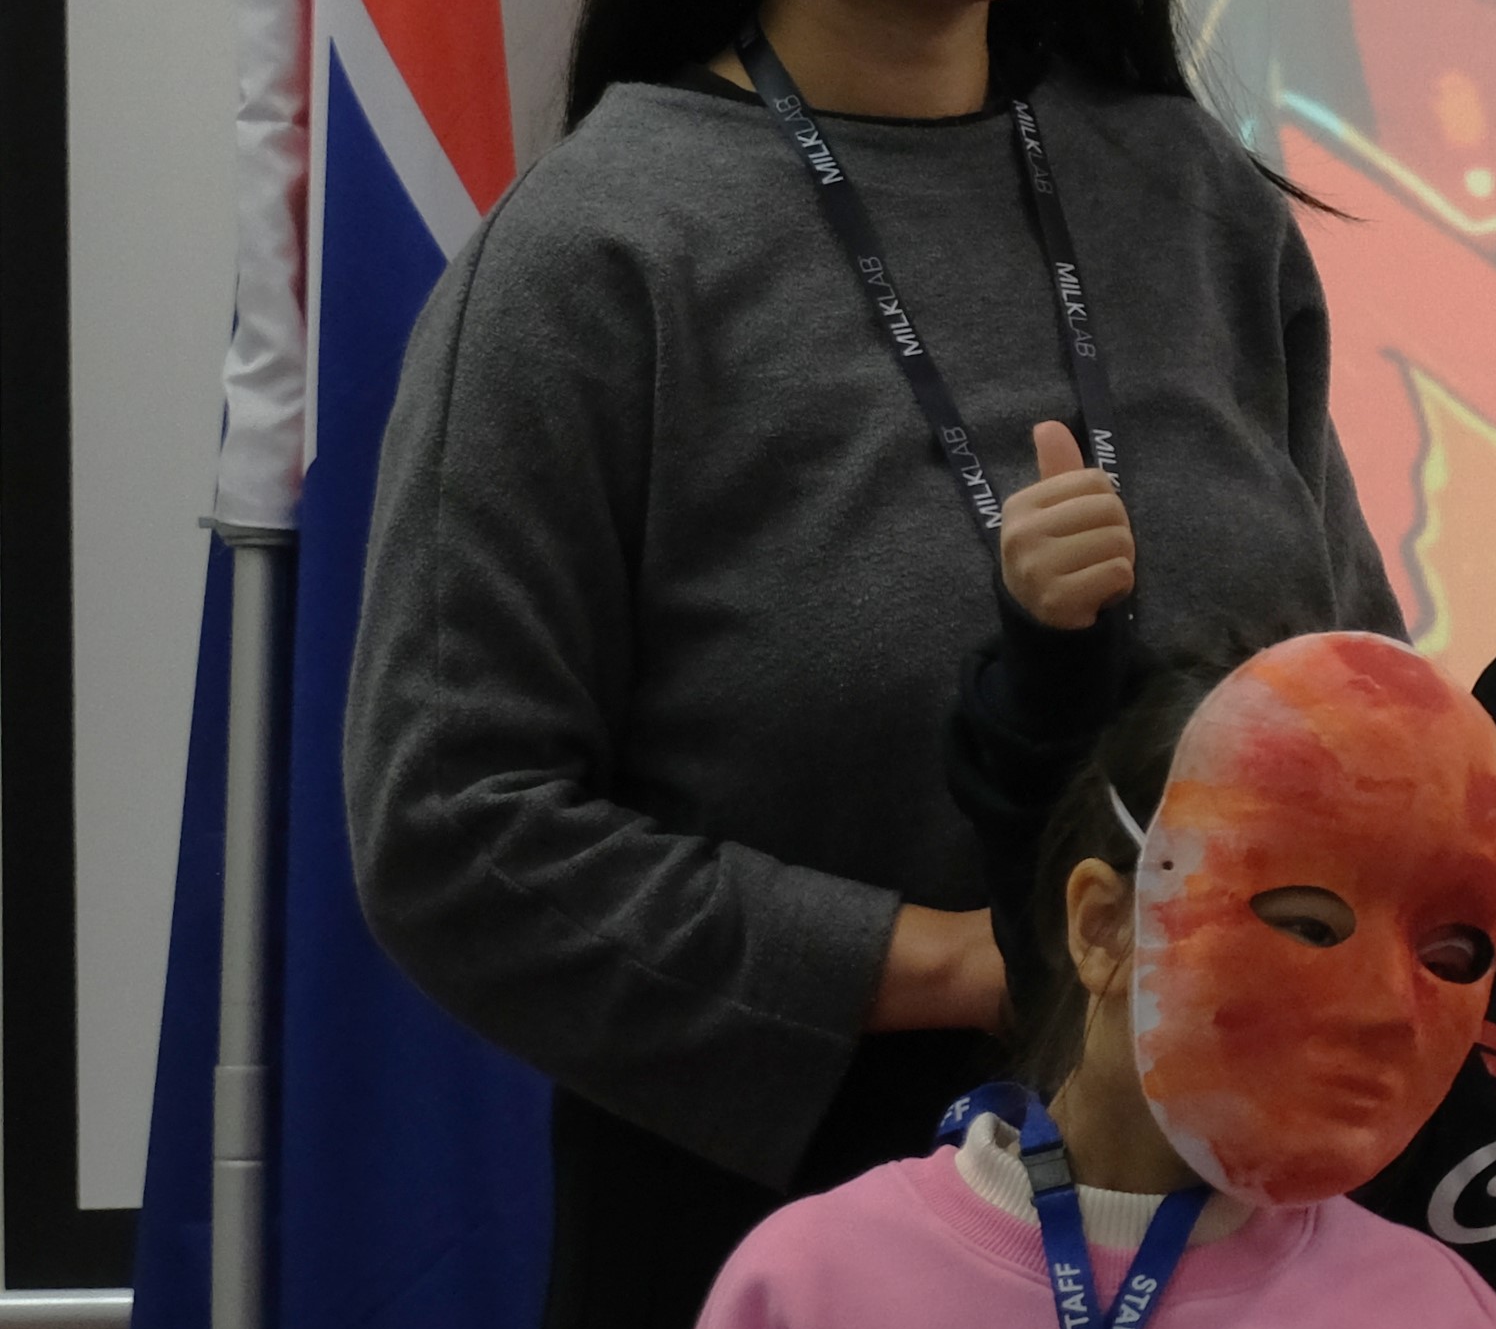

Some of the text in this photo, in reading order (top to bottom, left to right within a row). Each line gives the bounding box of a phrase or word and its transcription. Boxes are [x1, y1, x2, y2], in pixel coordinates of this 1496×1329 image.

[775, 94, 844, 185] MILKLAB
[1012, 99, 1051, 195] MILKLAB
[858, 256, 922, 357] MILKLAB
[1055, 262, 1097, 359] MILKLAB
[943, 426, 1002, 529] MILKLAB
